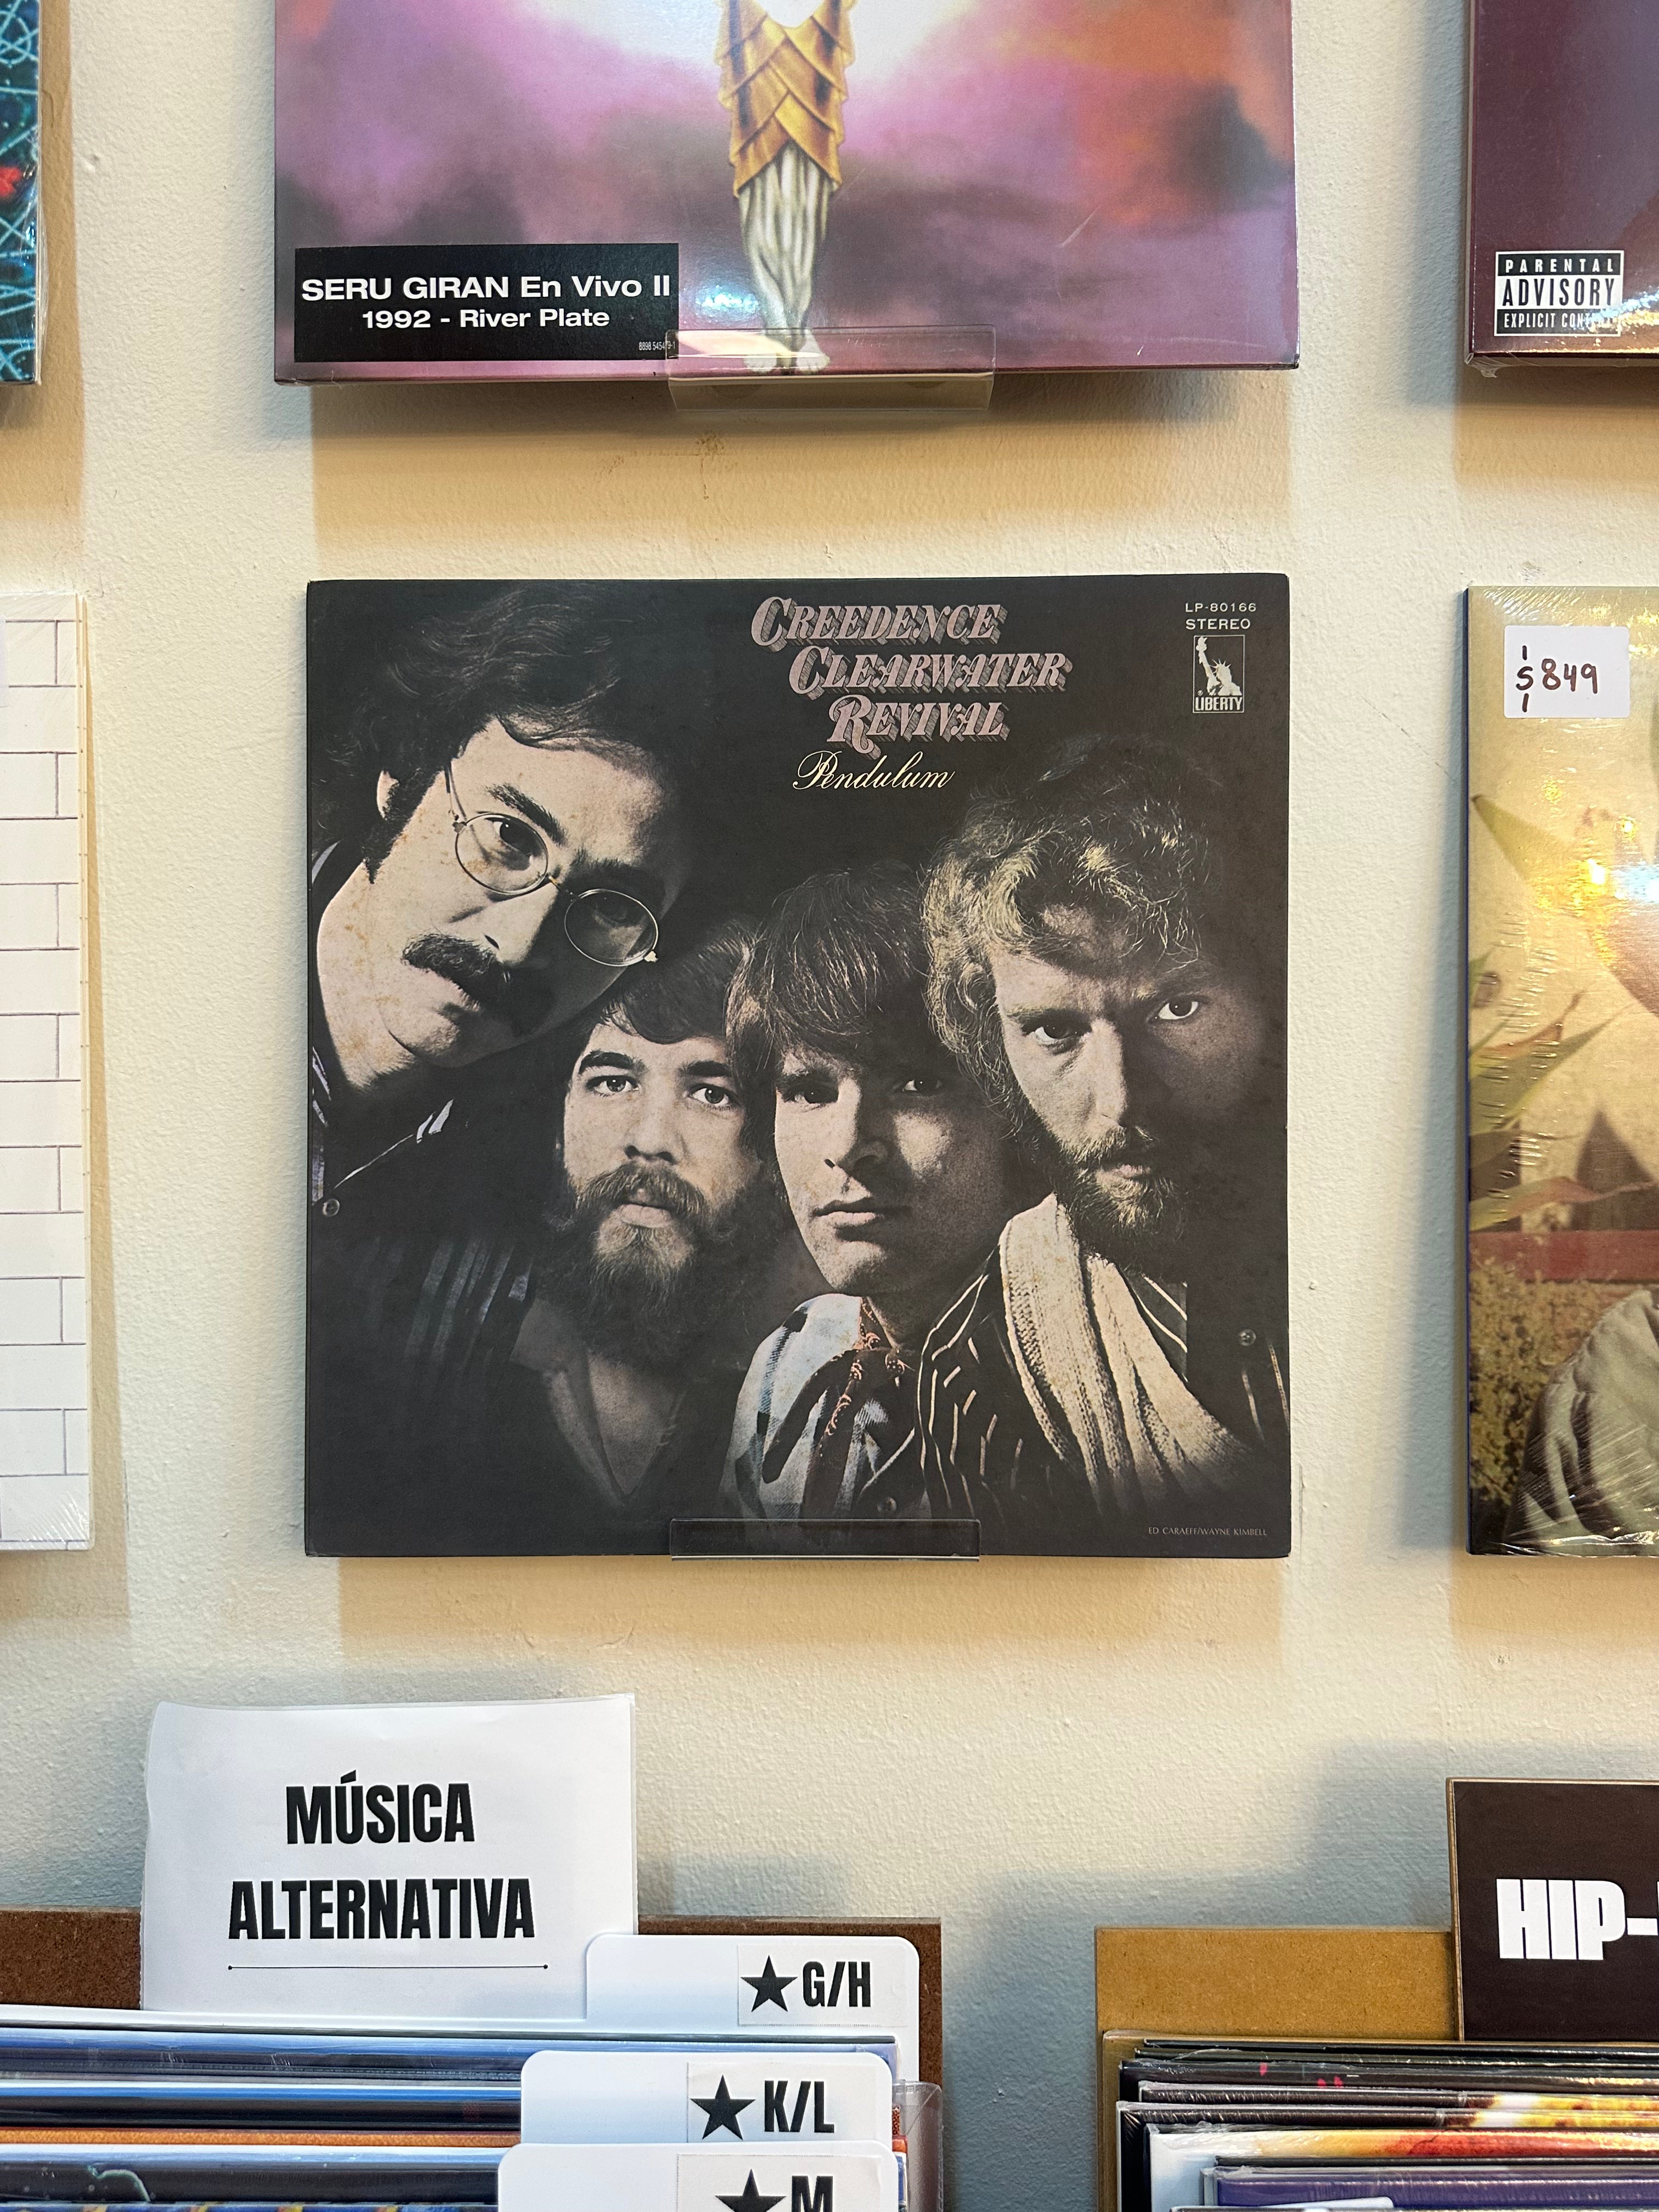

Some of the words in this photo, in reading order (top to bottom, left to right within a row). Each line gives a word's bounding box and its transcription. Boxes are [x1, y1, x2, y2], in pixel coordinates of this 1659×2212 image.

[1505, 258, 1614, 273] PARENTAL
[301, 278, 392, 301] SERU
[403, 276, 509, 300] GIRAN
[521, 276, 561, 298] En
[571, 275, 642, 298] Vivo
[653, 275, 671, 297] II
[1502, 278, 1615, 307] ADVISORY
[362, 310, 431, 329] 1992
[459, 309, 531, 328] River
[539, 308, 610, 327] Plate
[1504, 313, 1556, 328] EXPLICIT
[1561, 313, 1614, 329] CONT
[639, 341, 652, 351] 8898
[751, 596, 1008, 652] CREEDENCE
[1185, 603, 1257, 613] LP-80166
[1185, 618, 1251, 630] STEREO
[789, 645, 1074, 701] CLEARWATER
[1195, 697, 1243, 711] LIBERTY
[826, 694, 1011, 760] REVIVAL
[792, 751, 956, 791] Pendulum
[286, 1770, 475, 1844] MÚSICA
[228, 1878, 535, 1940] ALTERNATIVA
[1497, 1878, 1659, 1961] HIP-
[802, 1960, 871, 2008] G/H
[764, 2080, 834, 2134] K/L
[791, 2175, 833, 2212] M
